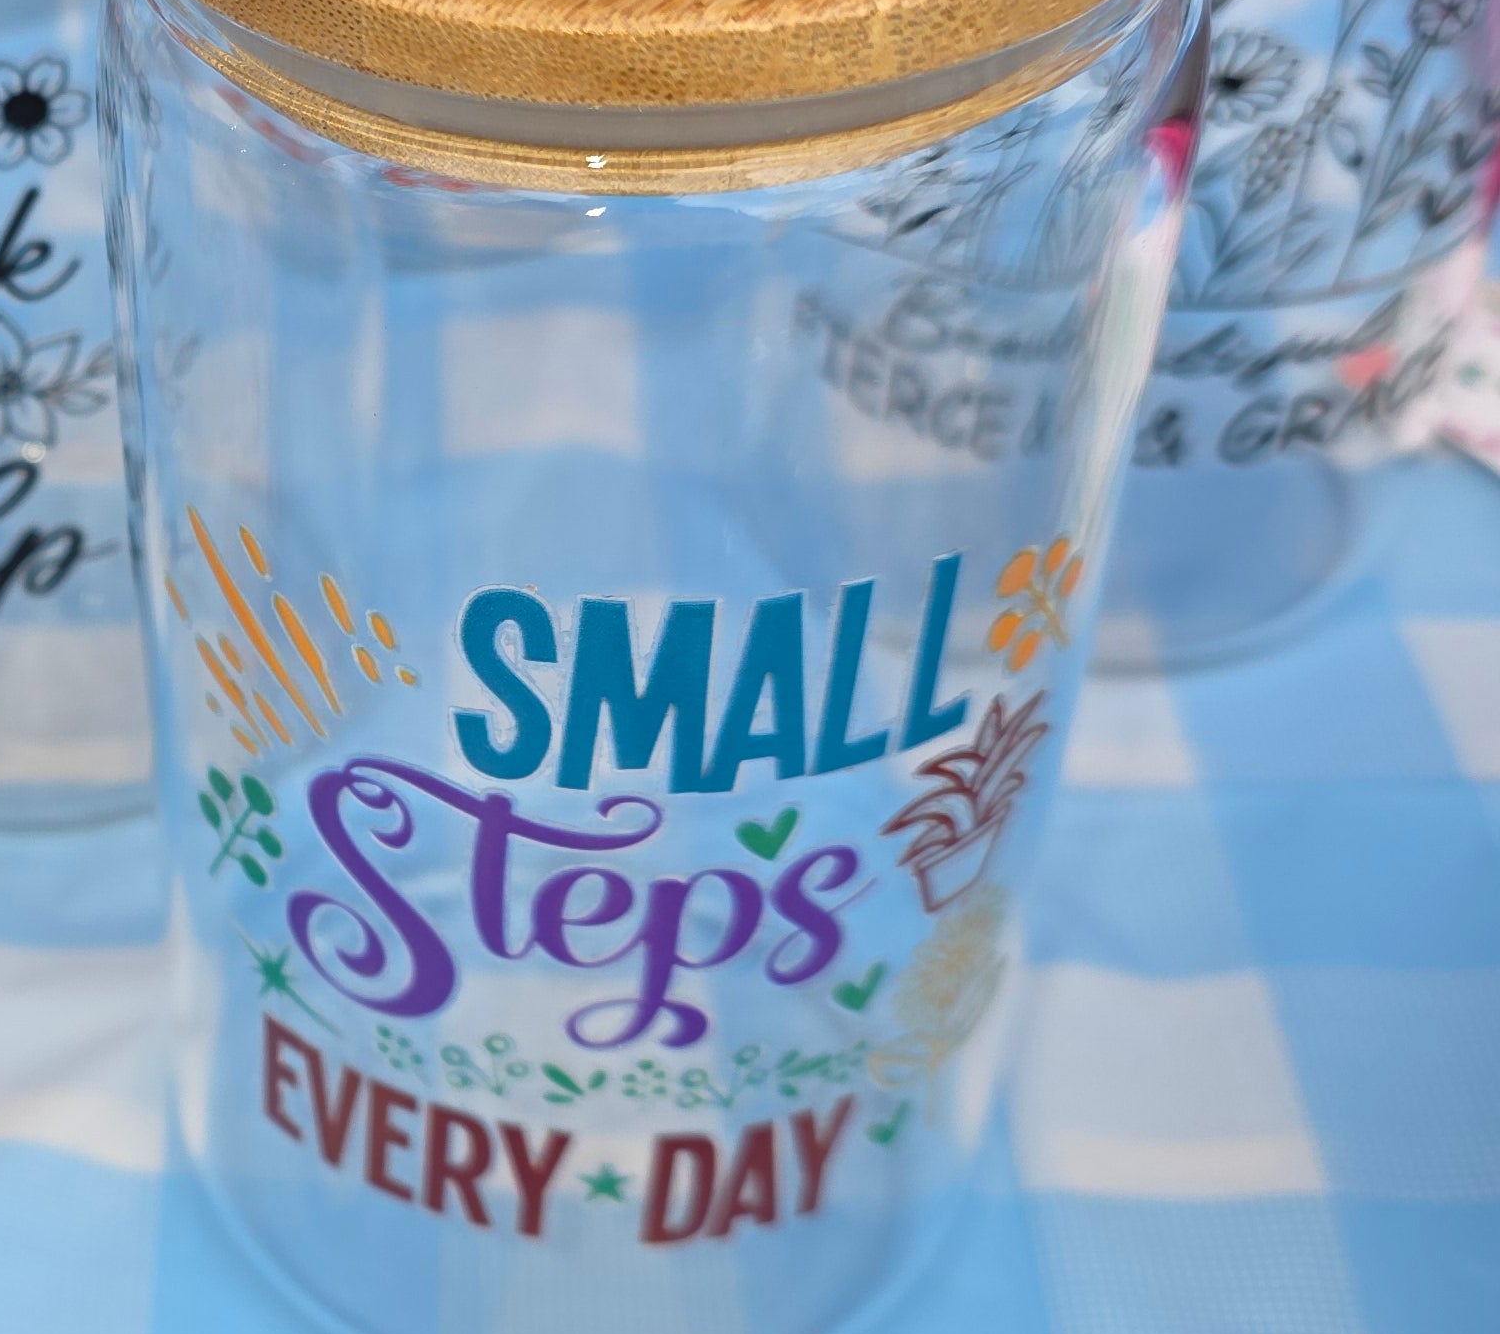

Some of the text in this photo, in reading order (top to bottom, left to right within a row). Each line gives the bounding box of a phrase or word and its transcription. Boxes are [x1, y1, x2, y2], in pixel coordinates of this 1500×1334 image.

[450, 549, 973, 795] SMALL
[286, 756, 882, 1050] Steps
[263, 1011, 857, 1245] EVERY DAY
